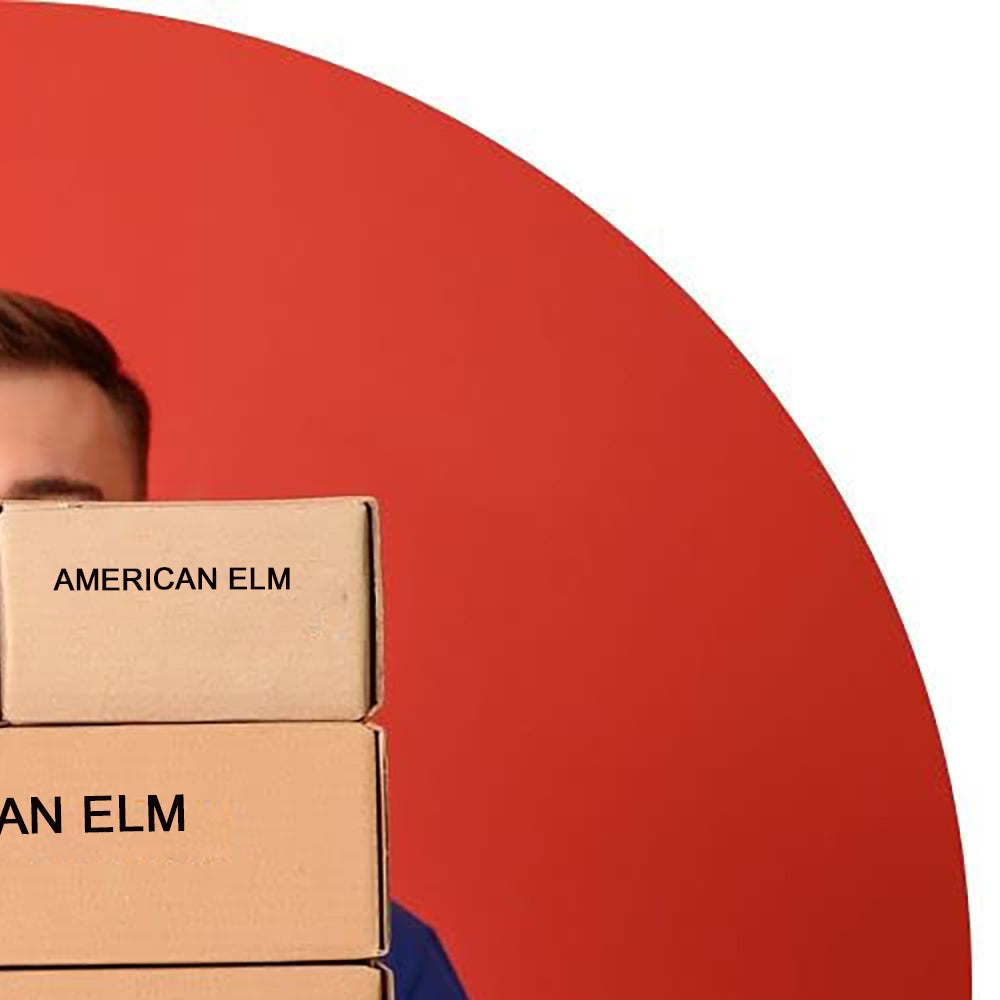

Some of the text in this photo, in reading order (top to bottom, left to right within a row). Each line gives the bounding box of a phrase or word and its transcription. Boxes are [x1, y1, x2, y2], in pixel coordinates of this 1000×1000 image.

[54, 567, 291, 591] AMERICAN ELM
[84, 794, 185, 834] ELM
